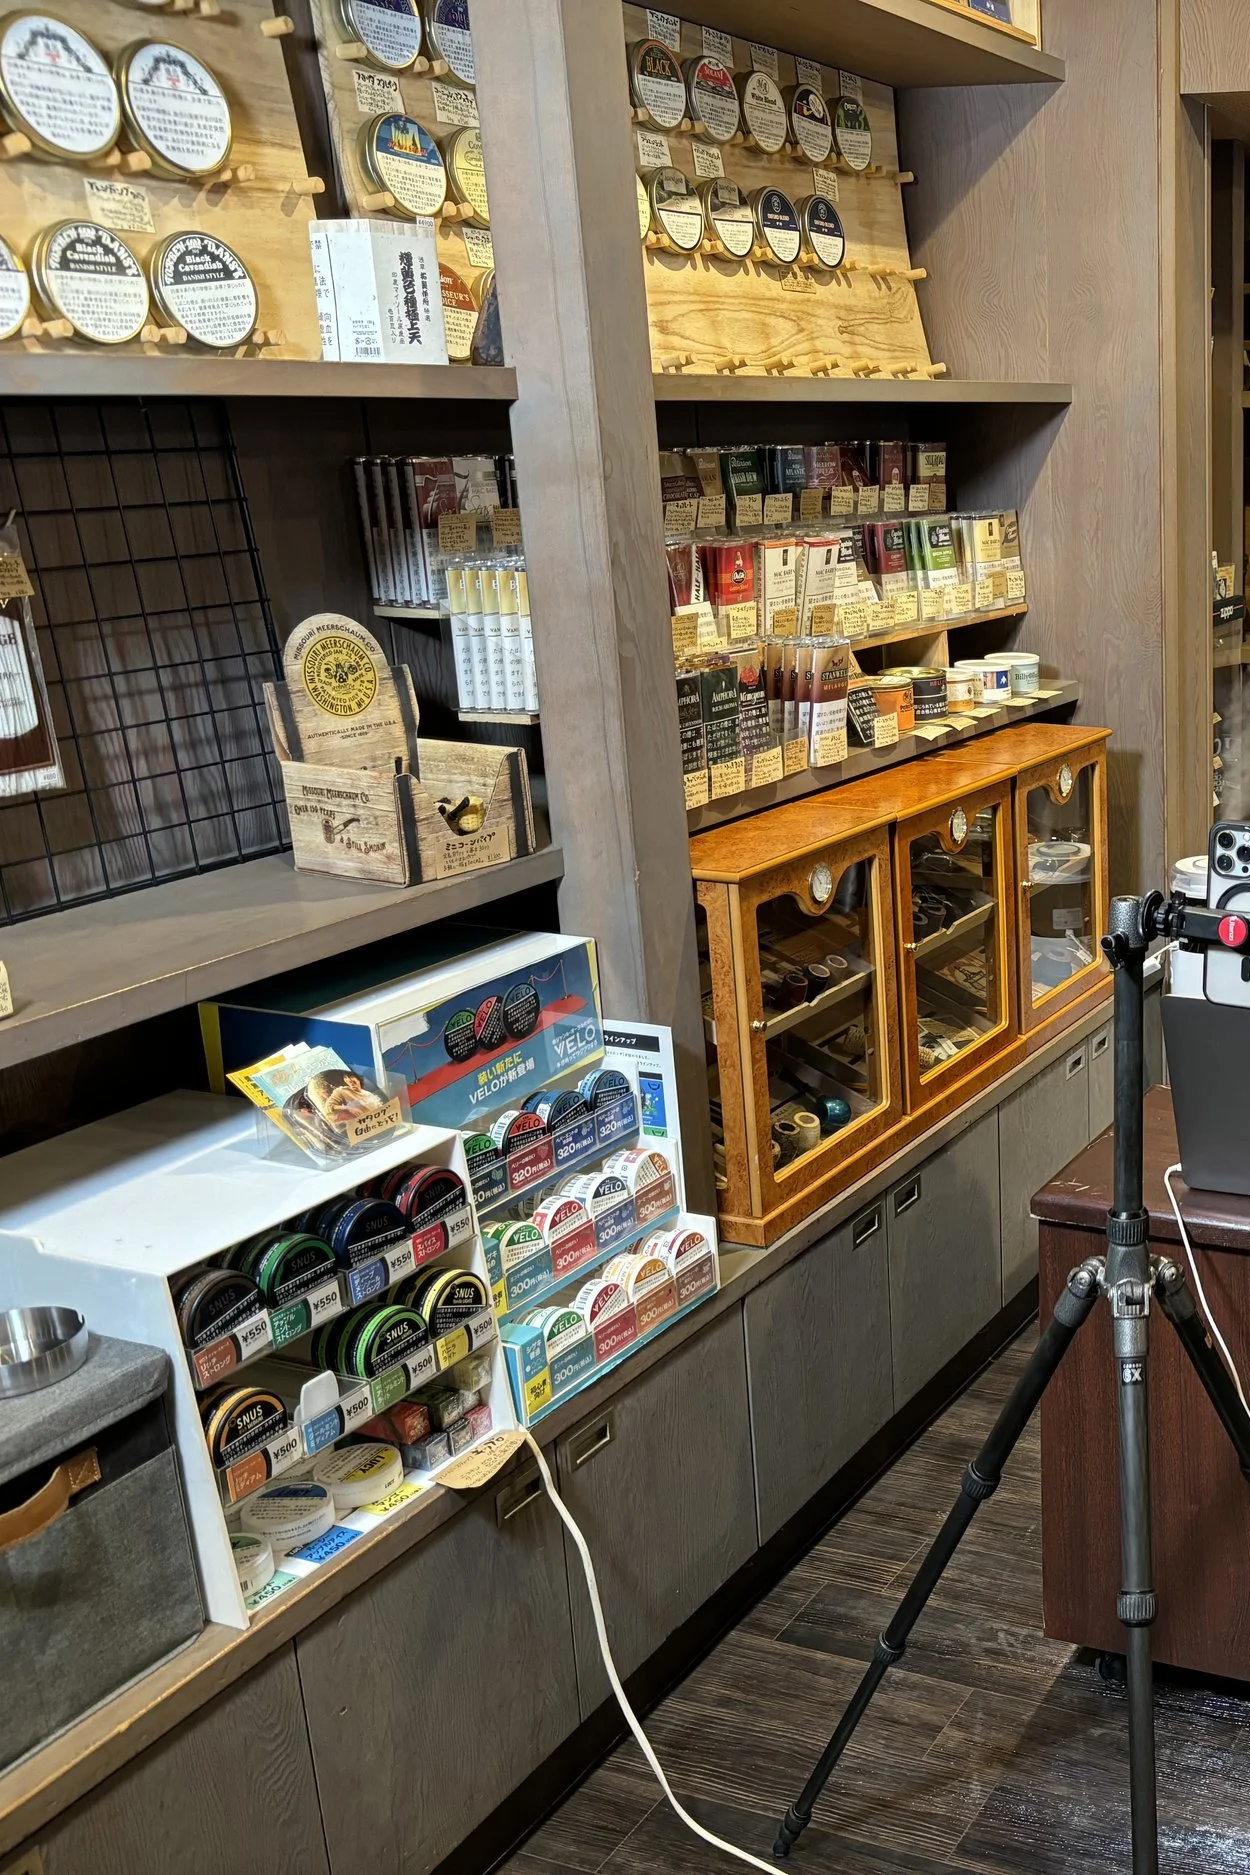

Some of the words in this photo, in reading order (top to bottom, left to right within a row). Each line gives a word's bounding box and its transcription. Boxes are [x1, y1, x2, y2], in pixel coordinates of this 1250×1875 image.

[646, 56, 671, 76] BLACK
[66, 250, 116, 264] Cavendish
[75, 242, 104, 254] Black
[178, 260, 223, 272] Cavendish
[185, 254, 211, 264] Black
[201, 238, 245, 280] DANSK
[182, 272, 205, 282] DANISH
[205, 271, 226, 280] STYLE
[441, 289, 470, 302] SSEUR'S
[1220, 604, 1234, 620] zippo
[294, 629, 316, 660] MISSOURI
[316, 624, 366, 641] MEERSCHAUM
[307, 647, 322, 684] MISSOURI
[320, 639, 365, 661] MEERSCHAUM
[311, 686, 355, 713] WASHINGTON,
[321, 686, 348, 704] PATENTED
[678, 691, 700, 706] MPHORA
[711, 688, 738, 703] AMPHORA
[711, 704, 721, 712] RICH
[721, 702, 738, 711] AROMA
[307, 728, 349, 740] AUTHENTICALLY
[350, 725, 366, 733] MADE
[309, 805, 319, 814] 150
[319, 807, 337, 820] YEARS
[445, 832, 497, 851] ミニコーンパイプ
[510, 985, 531, 1001] VELO
[450, 1013, 473, 1029] VELO
[476, 999, 493, 1030] VELO
[554, 1024, 596, 1058] VELO
[477, 1050, 523, 1086] 装い新たに
[469, 1057, 536, 1105] VELOが新登場
[602, 1077, 625, 1089] VELO
[556, 1095, 580, 1115] VELO
[355, 1105, 392, 1125] カタログ
[515, 1118, 540, 1132] VELO
[464, 1139, 492, 1155] VELO
[423, 1183, 446, 1200] SNUS
[472, 1181, 506, 1205] 20円(税込)
[598, 1182, 622, 1195] VELO
[553, 1203, 579, 1223] VELO
[365, 1215, 389, 1233] SNUS
[449, 1217, 470, 1234] ¥550
[416, 1237, 437, 1252] スパイス
[513, 1230, 540, 1242] VELO
[679, 1235, 701, 1252] VELO
[418, 1241, 441, 1258] ストロング
[290, 1250, 316, 1272] SNUS
[390, 1250, 412, 1269] ¥550
[640, 1261, 664, 1278] VELO
[312, 1290, 338, 1312] ¥550
[454, 1287, 474, 1298] SNUS
[593, 1284, 615, 1313] VELO
[208, 1288, 236, 1316] SNUS
[272, 1313, 296, 1330] アップル
[473, 1316, 493, 1335] ¥500
[552, 1314, 578, 1335] VELO
[241, 1319, 268, 1344] ¥550
[274, 1324, 291, 1338] ミント
[276, 1324, 302, 1345] ストロング
[386, 1321, 410, 1343] SNUS
[200, 1356, 217, 1372] リッチ
[203, 1355, 231, 1379] ストロング
[411, 1355, 433, 1374] ¥500
[1122, 1368, 1143, 1383] 6X
[530, 1378, 547, 1395] 初心者
[533, 1389, 546, 1401] 向け
[345, 1396, 369, 1417] ¥500
[236, 1405, 263, 1430] SNUS
[273, 1438, 298, 1459] ¥500
[359, 1455, 385, 1475] LUCY
[380, 1493, 411, 1512] ¥450
[314, 1540, 345, 1562] ¥450
[249, 1585, 282, 1606] ¥450
